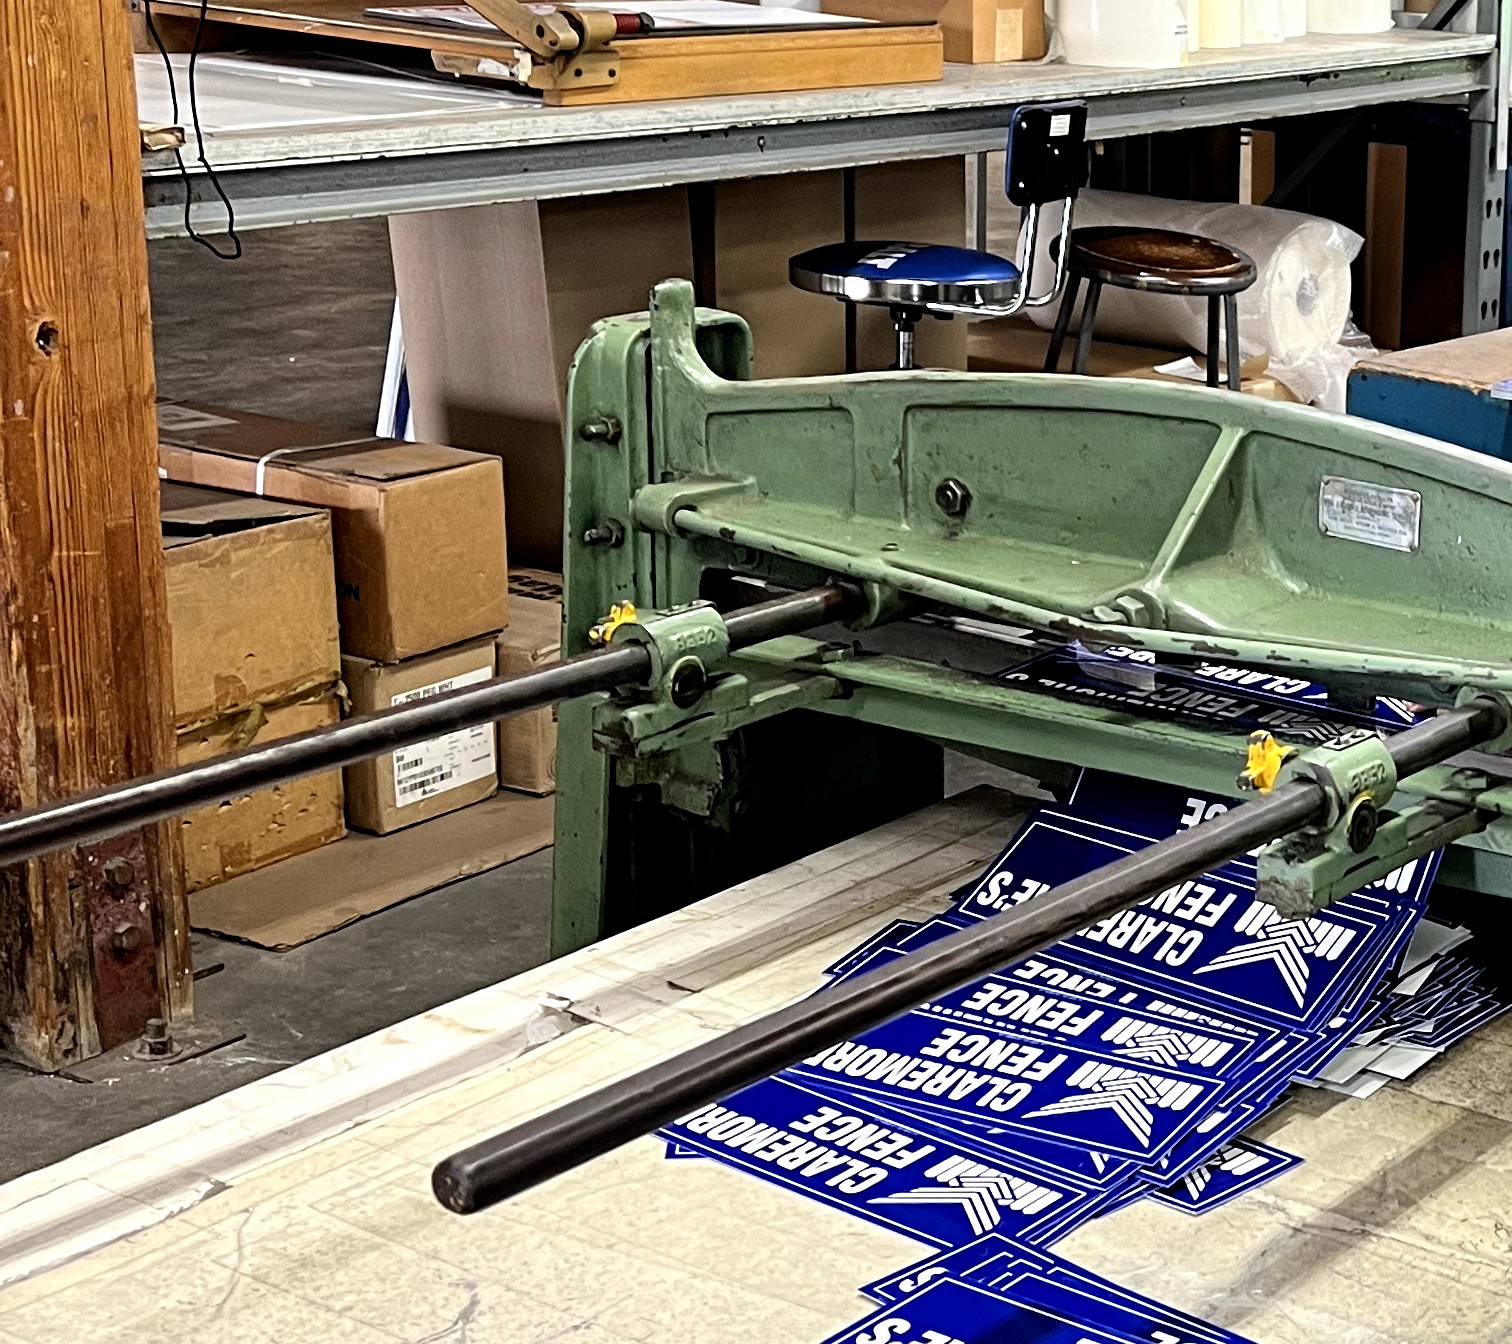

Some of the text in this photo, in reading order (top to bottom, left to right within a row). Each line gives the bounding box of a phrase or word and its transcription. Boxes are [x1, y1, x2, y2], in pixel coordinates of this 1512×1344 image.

[960, 981, 1105, 1037] FENCE
[919, 1027, 1069, 1082] FENCE
[788, 1105, 937, 1170] FENCE
